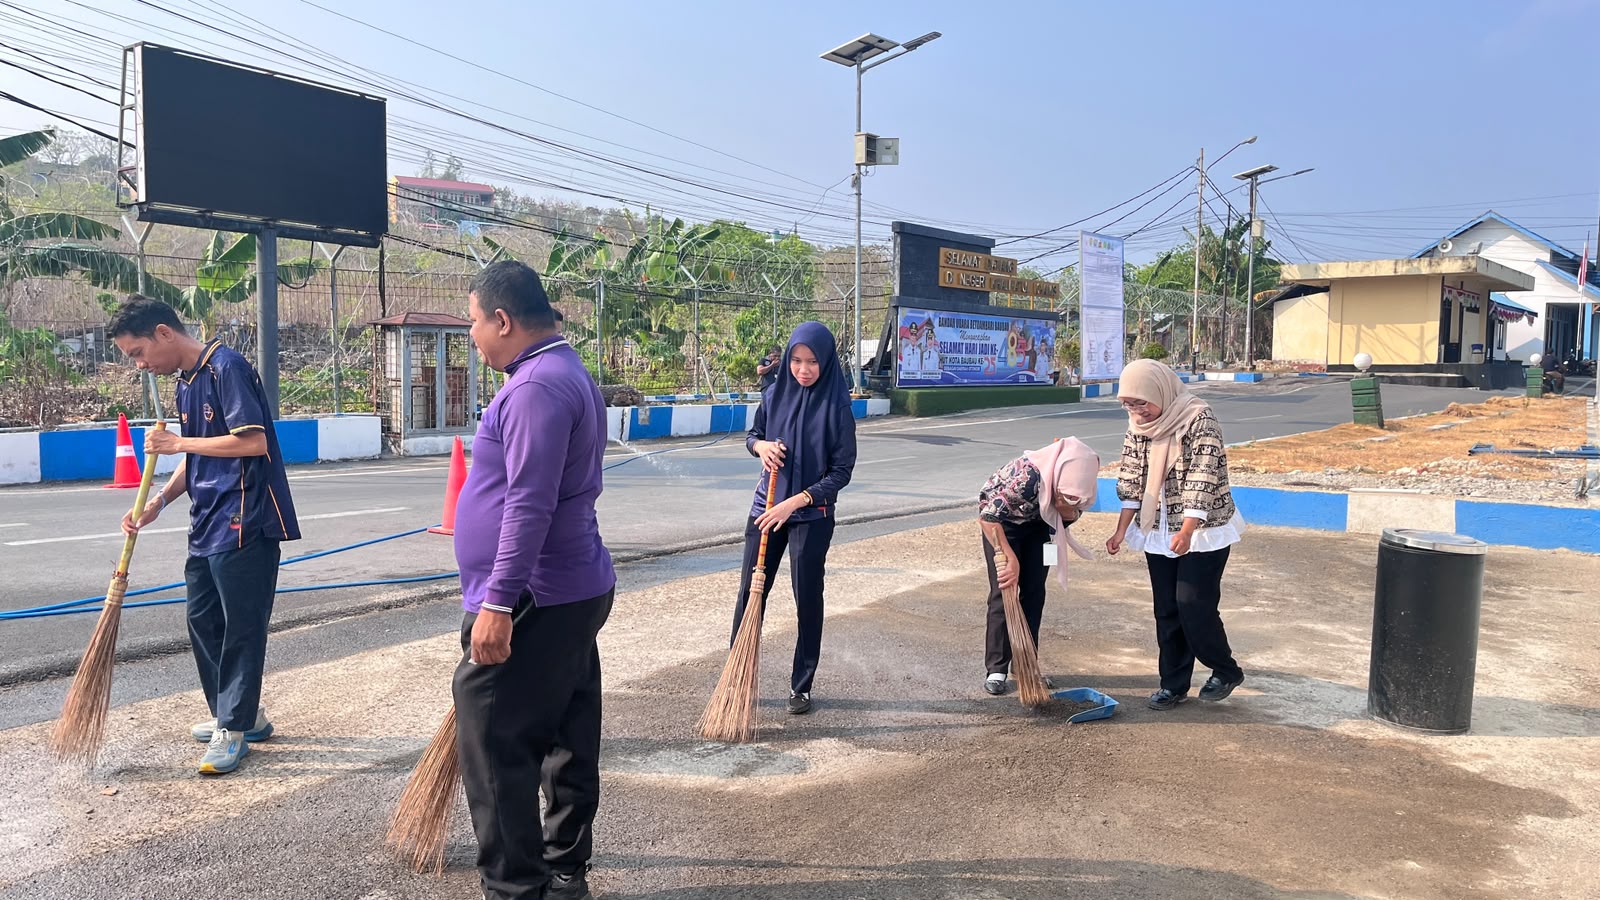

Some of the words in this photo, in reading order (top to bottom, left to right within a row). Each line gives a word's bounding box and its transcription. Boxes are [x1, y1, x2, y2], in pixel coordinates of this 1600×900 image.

[946, 250, 982, 268] SELAMAT
[940, 341, 964, 354] SELAMAT
[965, 342, 978, 355] HARI
[979, 343, 990, 355] JADI
[949, 356, 960, 365] KOTA
